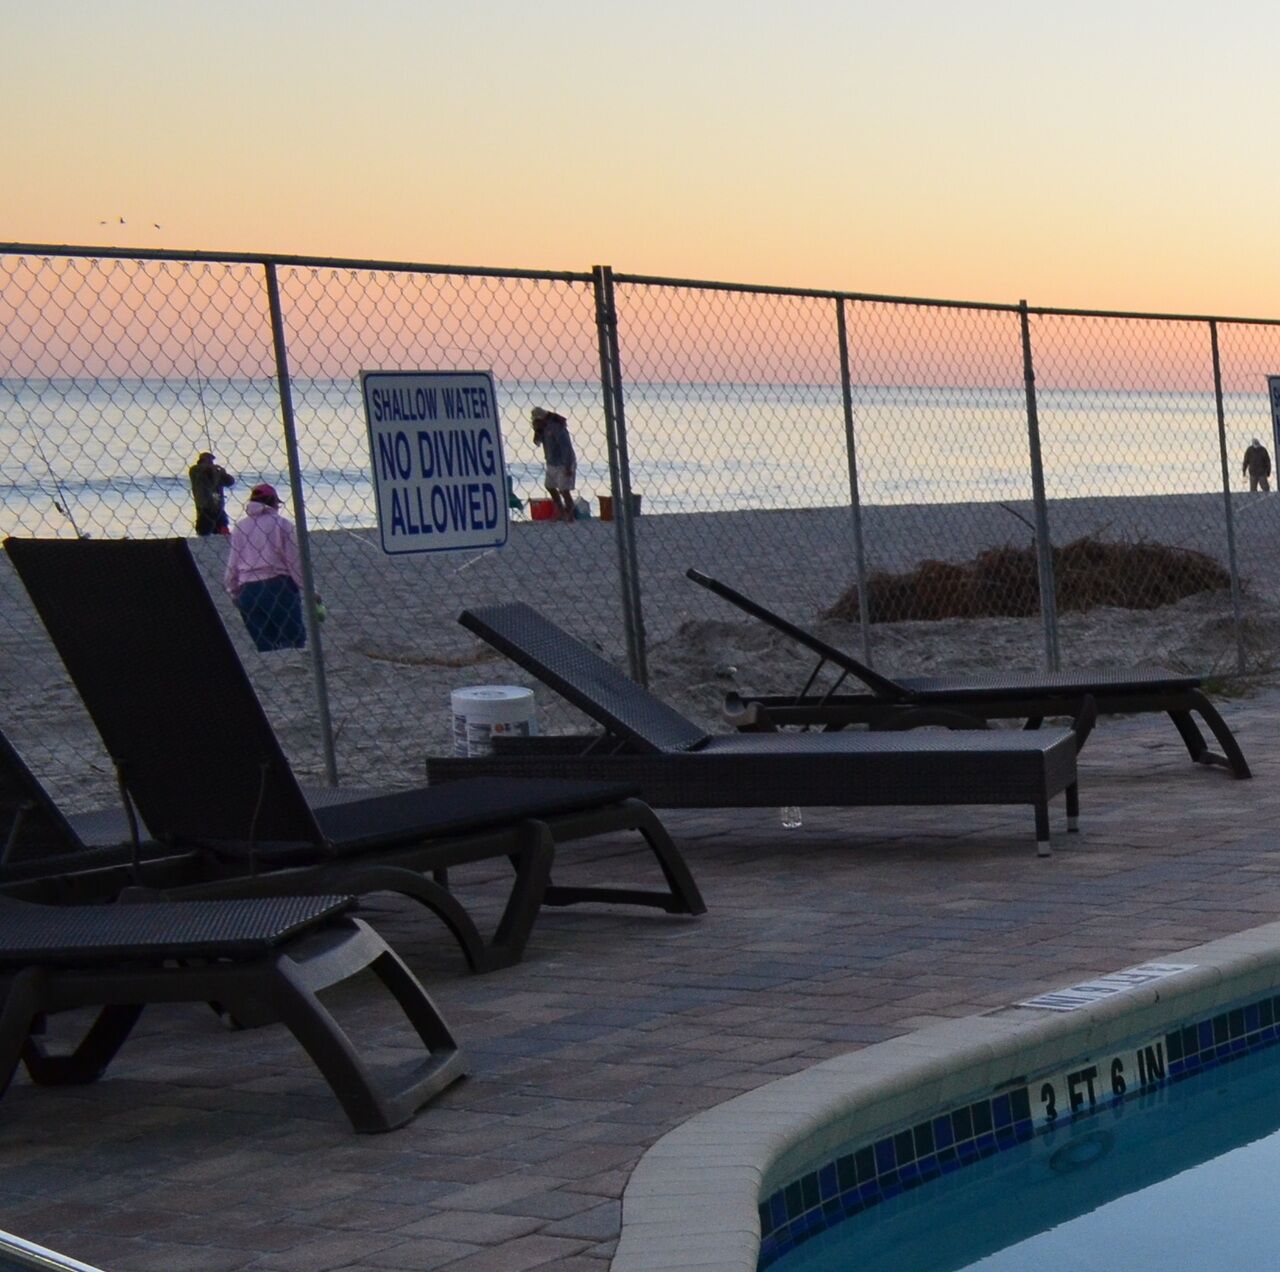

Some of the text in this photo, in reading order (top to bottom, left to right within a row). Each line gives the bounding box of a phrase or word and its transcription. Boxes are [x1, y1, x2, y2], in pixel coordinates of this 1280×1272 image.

[372, 387, 490, 422] SHALLOW WATER
[378, 428, 497, 481] NO DIVING
[391, 483, 498, 536] ALLOWED
[1041, 1042, 1166, 1122] 3 FT 6 IN
